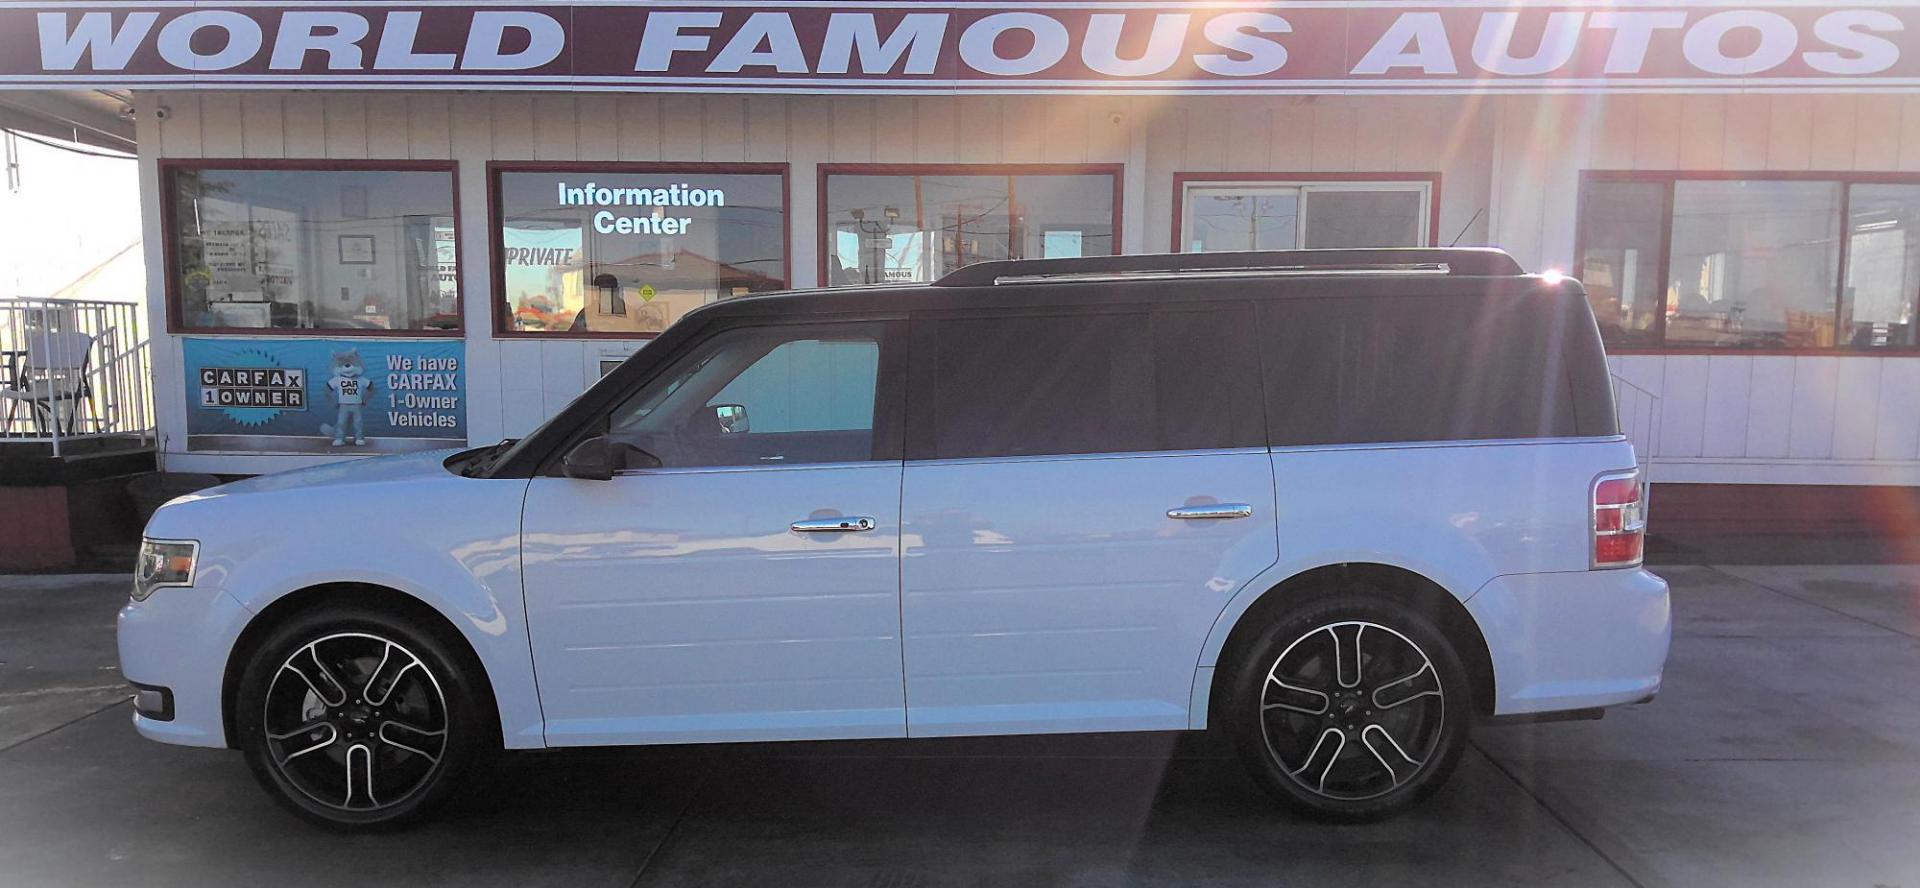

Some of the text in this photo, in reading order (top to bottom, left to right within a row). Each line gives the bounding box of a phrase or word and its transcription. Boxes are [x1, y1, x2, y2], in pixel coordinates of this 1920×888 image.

[37, 9, 1905, 76] WORLD FAMOUS AUTOS
[558, 182, 725, 207] Information
[593, 210, 692, 235] Center
[504, 247, 574, 266] PRIVATE
[386, 354, 458, 371] We have
[203, 370, 300, 388] CARFAX
[341, 380, 358, 388] CAR
[387, 373, 457, 390] CARFAX
[205, 390, 301, 405] 1 OWNER
[342, 388, 358, 396] FOX
[388, 393, 458, 409] 1-Owner
[387, 411, 457, 428] Vehicles
